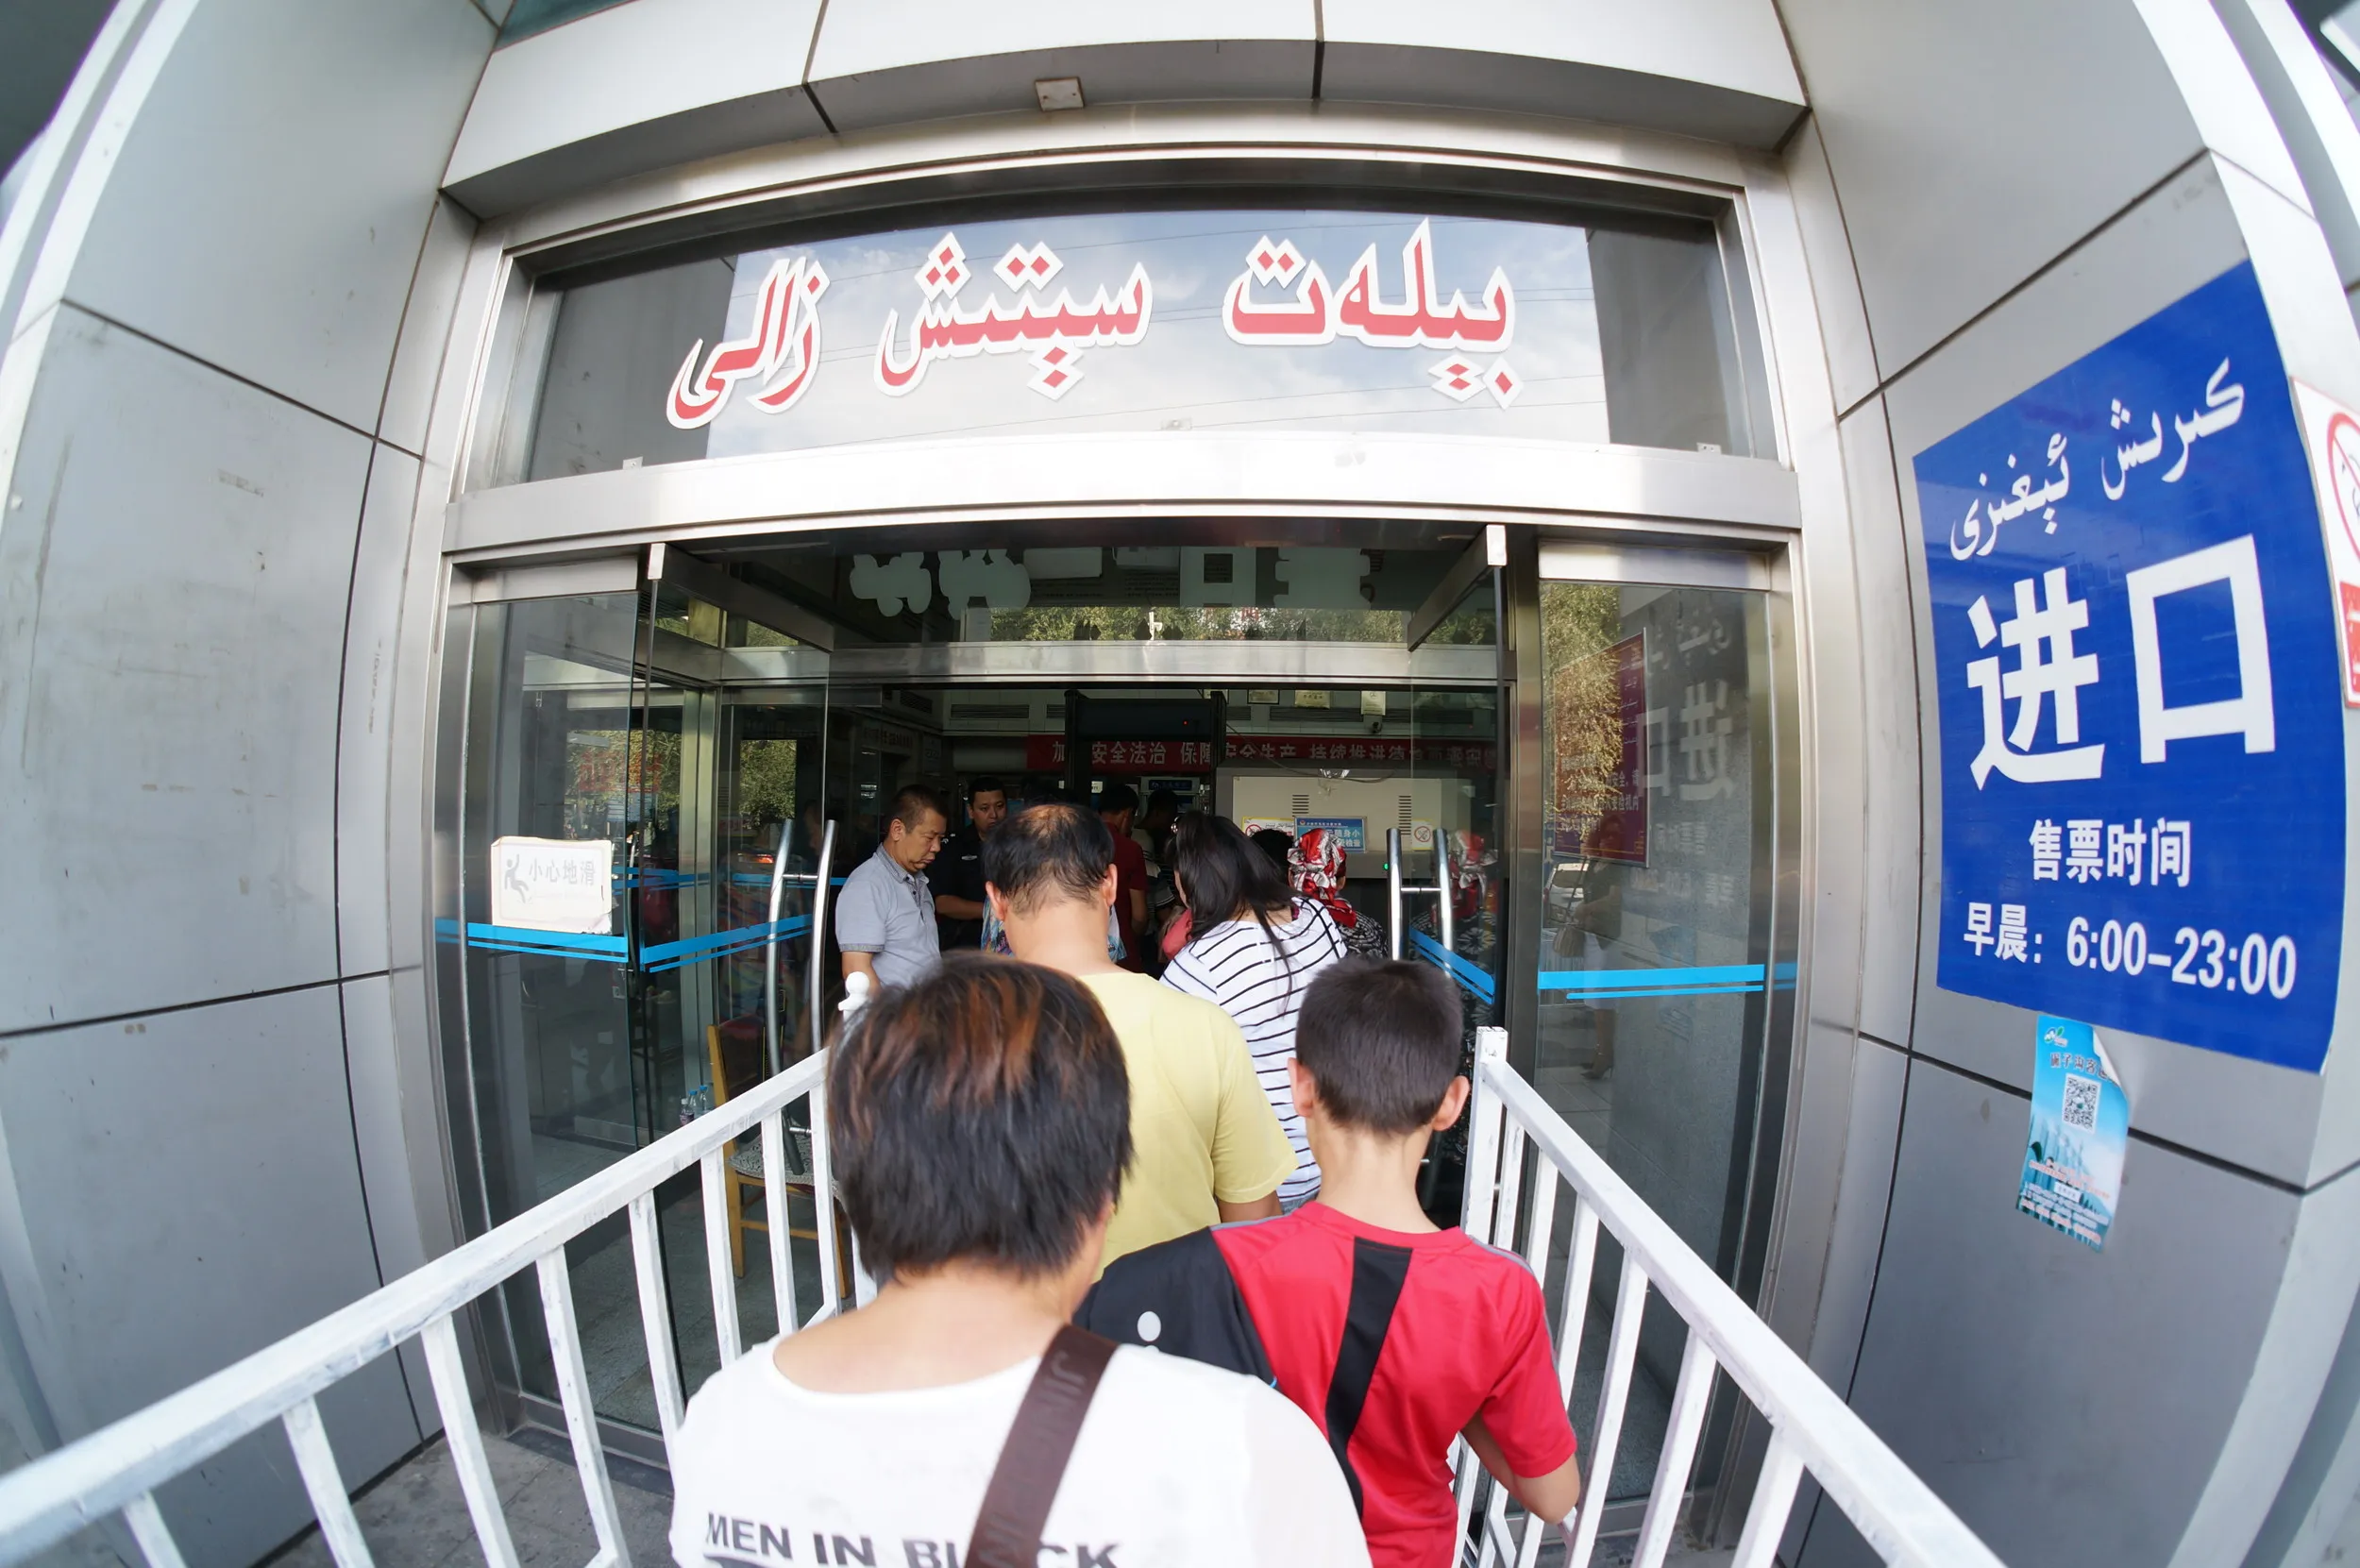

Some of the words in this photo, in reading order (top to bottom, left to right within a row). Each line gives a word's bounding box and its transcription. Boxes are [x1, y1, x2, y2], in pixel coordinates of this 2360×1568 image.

[1966, 533, 2276, 791] 进口
[1052, 741, 1167, 766] 加安全法治
[529, 858, 596, 886] 小心地滑
[2029, 818, 2191, 888] 售票时间
[705, 1510, 793, 1560] MEN
[813, 1531, 877, 1567] IN
[902, 1535, 1121, 1568] BLCK
